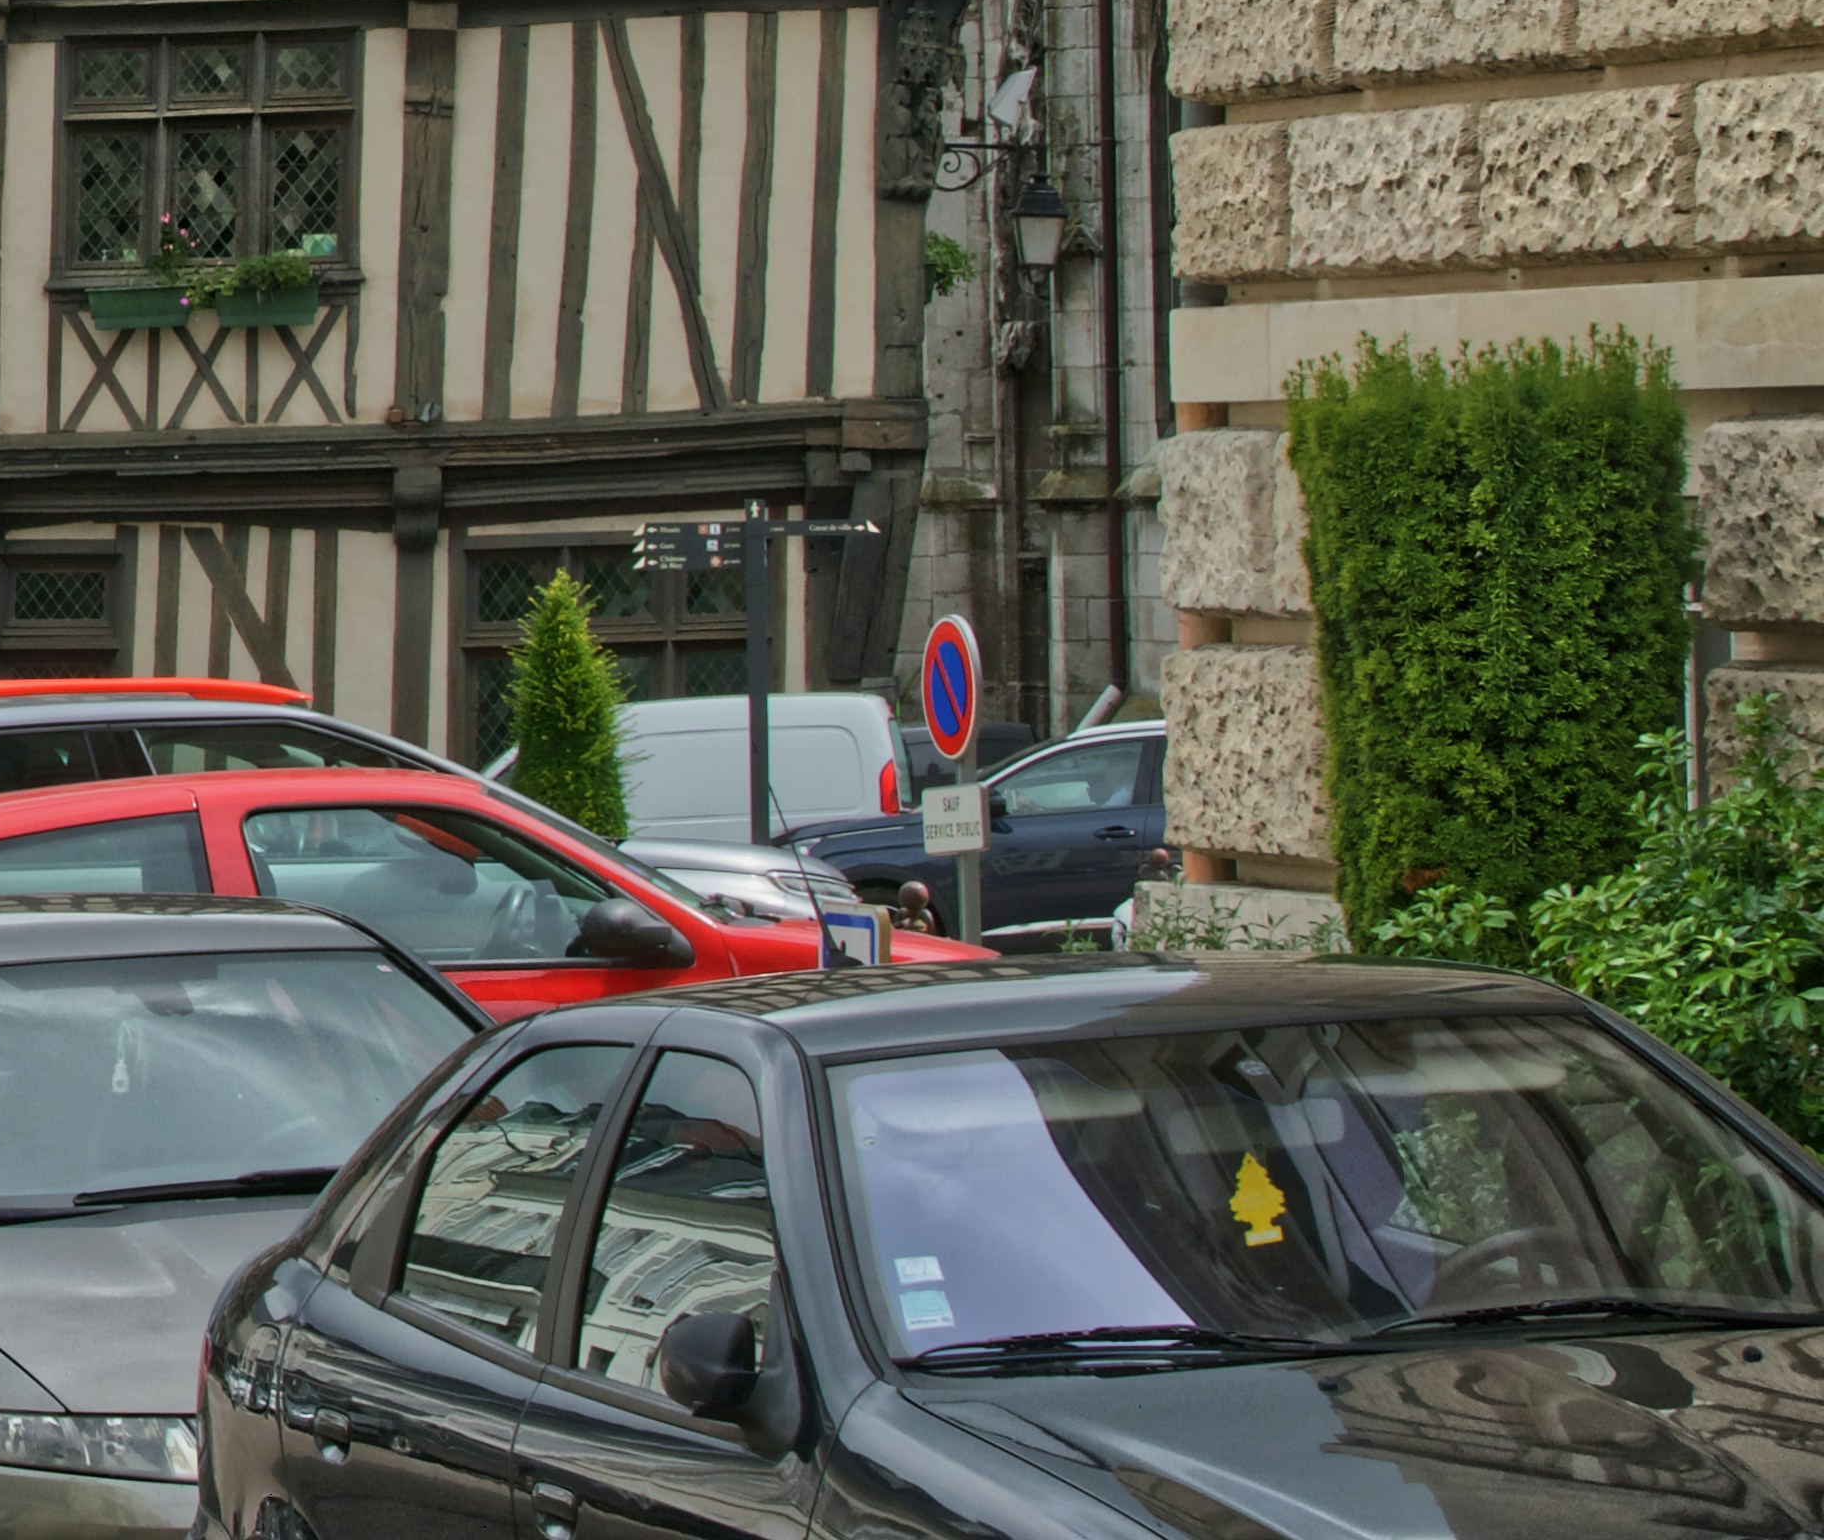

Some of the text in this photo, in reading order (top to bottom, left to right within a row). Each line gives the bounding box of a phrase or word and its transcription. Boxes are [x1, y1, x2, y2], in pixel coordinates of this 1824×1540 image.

[942, 795, 960, 813] SAUF
[925, 820, 981, 840] SERVICE PUBLIC
